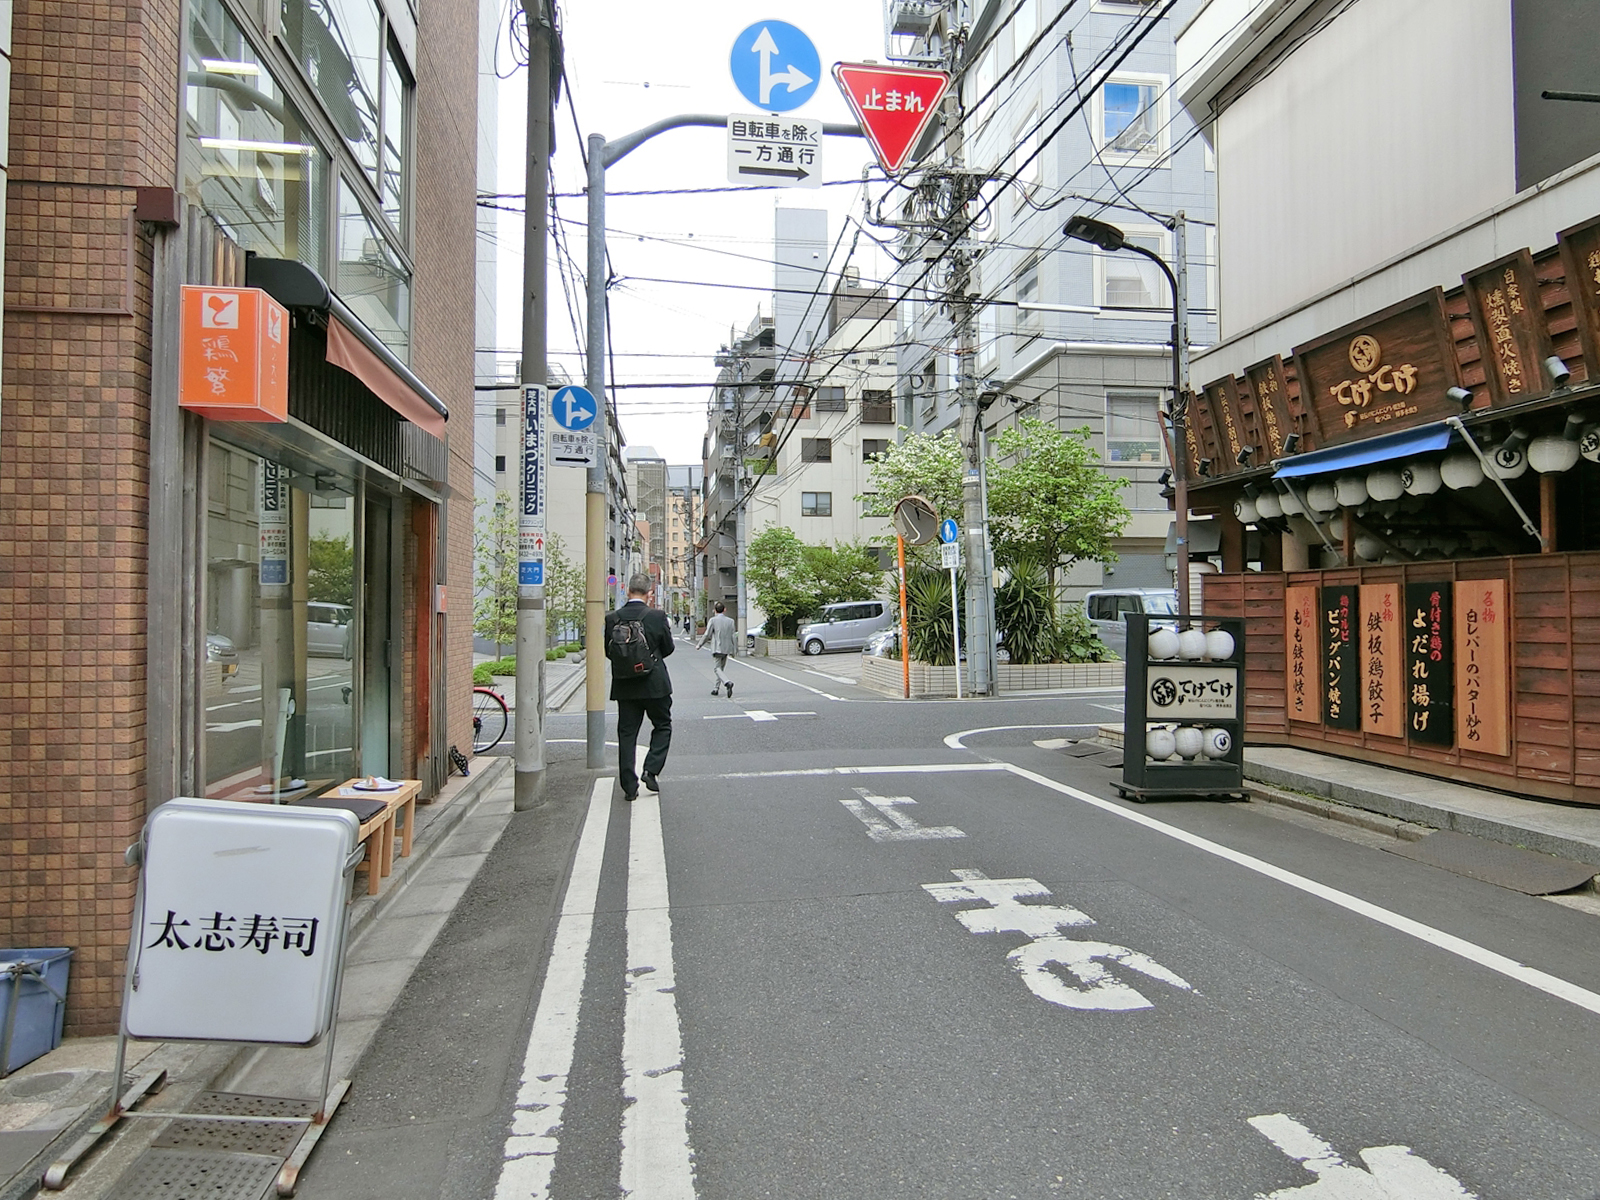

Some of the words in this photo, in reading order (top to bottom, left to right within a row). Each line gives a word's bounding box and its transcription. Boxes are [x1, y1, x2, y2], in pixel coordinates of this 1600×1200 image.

[862, 87, 925, 113] 止まれ
[732, 119, 818, 142] 自転車を除く
[734, 145, 815, 165] 一方通行
[1503, 268, 1525, 314] 自家製
[1329, 363, 1419, 408] てけてけ
[552, 434, 594, 444] 自転車を除く
[552, 445, 594, 455] 一方通行
[1382, 593, 1394, 622] 名物
[1429, 591, 1443, 662] 骨付き鶏の
[1482, 591, 1496, 624] 名物
[1293, 609, 1305, 712] もも鉄板焼き
[1367, 611, 1385, 724] 鉄板鶏餃子
[1412, 608, 1431, 732] よだれ揚げ
[1466, 608, 1482, 742] 白レバーのバター炒め
[1178, 678, 1234, 698] てけてけ
[145, 909, 320, 957] 太志寿司
